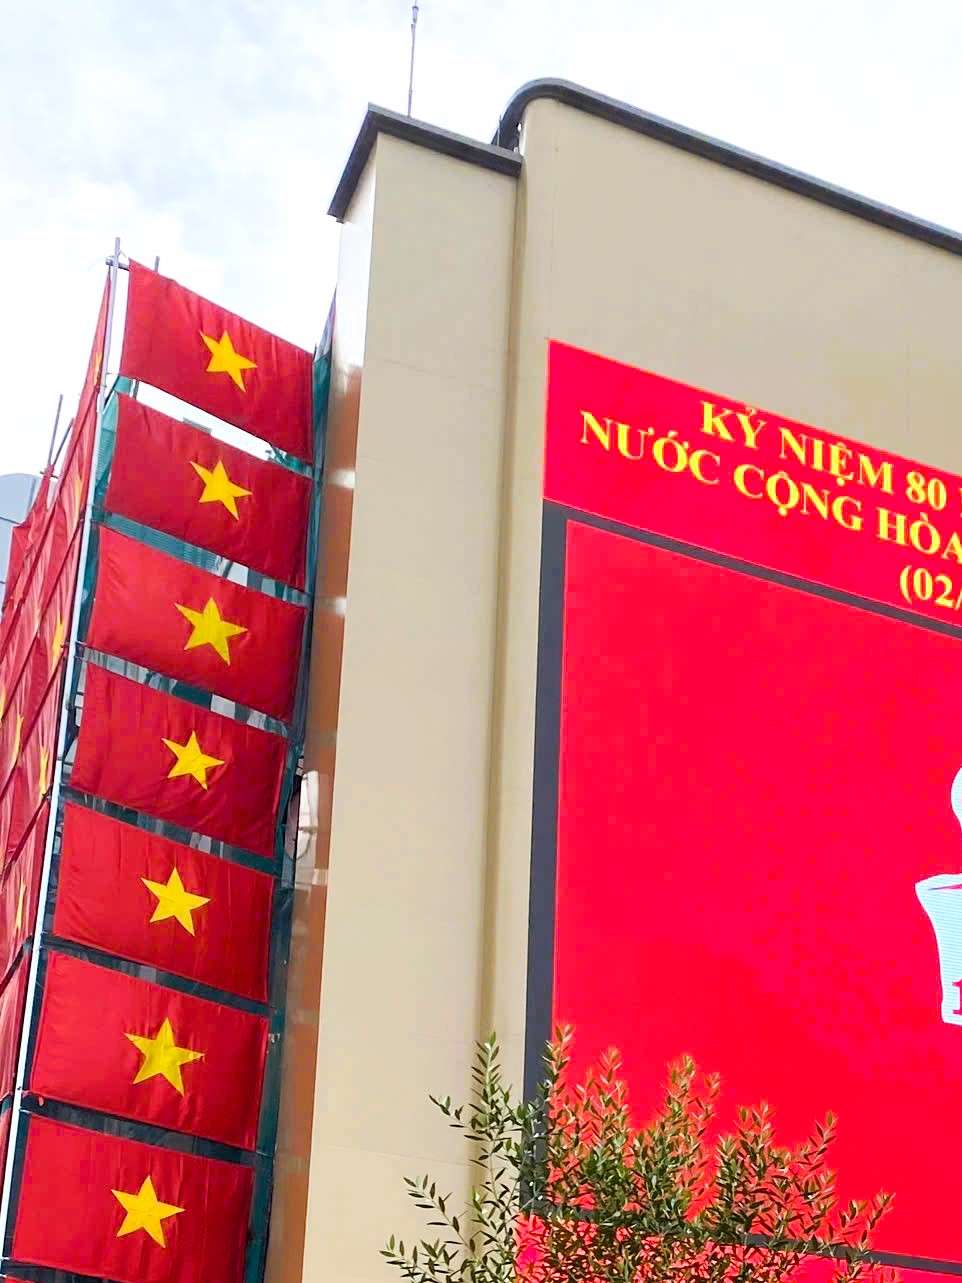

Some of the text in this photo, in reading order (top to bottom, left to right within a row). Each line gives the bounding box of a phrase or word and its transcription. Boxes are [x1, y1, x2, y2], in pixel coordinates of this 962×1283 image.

[579, 410, 721, 485] NƯỚC
[733, 463, 864, 532] CỘNG
[700, 401, 767, 450] KỶ
[779, 427, 896, 495] NIỆM
[906, 470, 948, 511] 80
